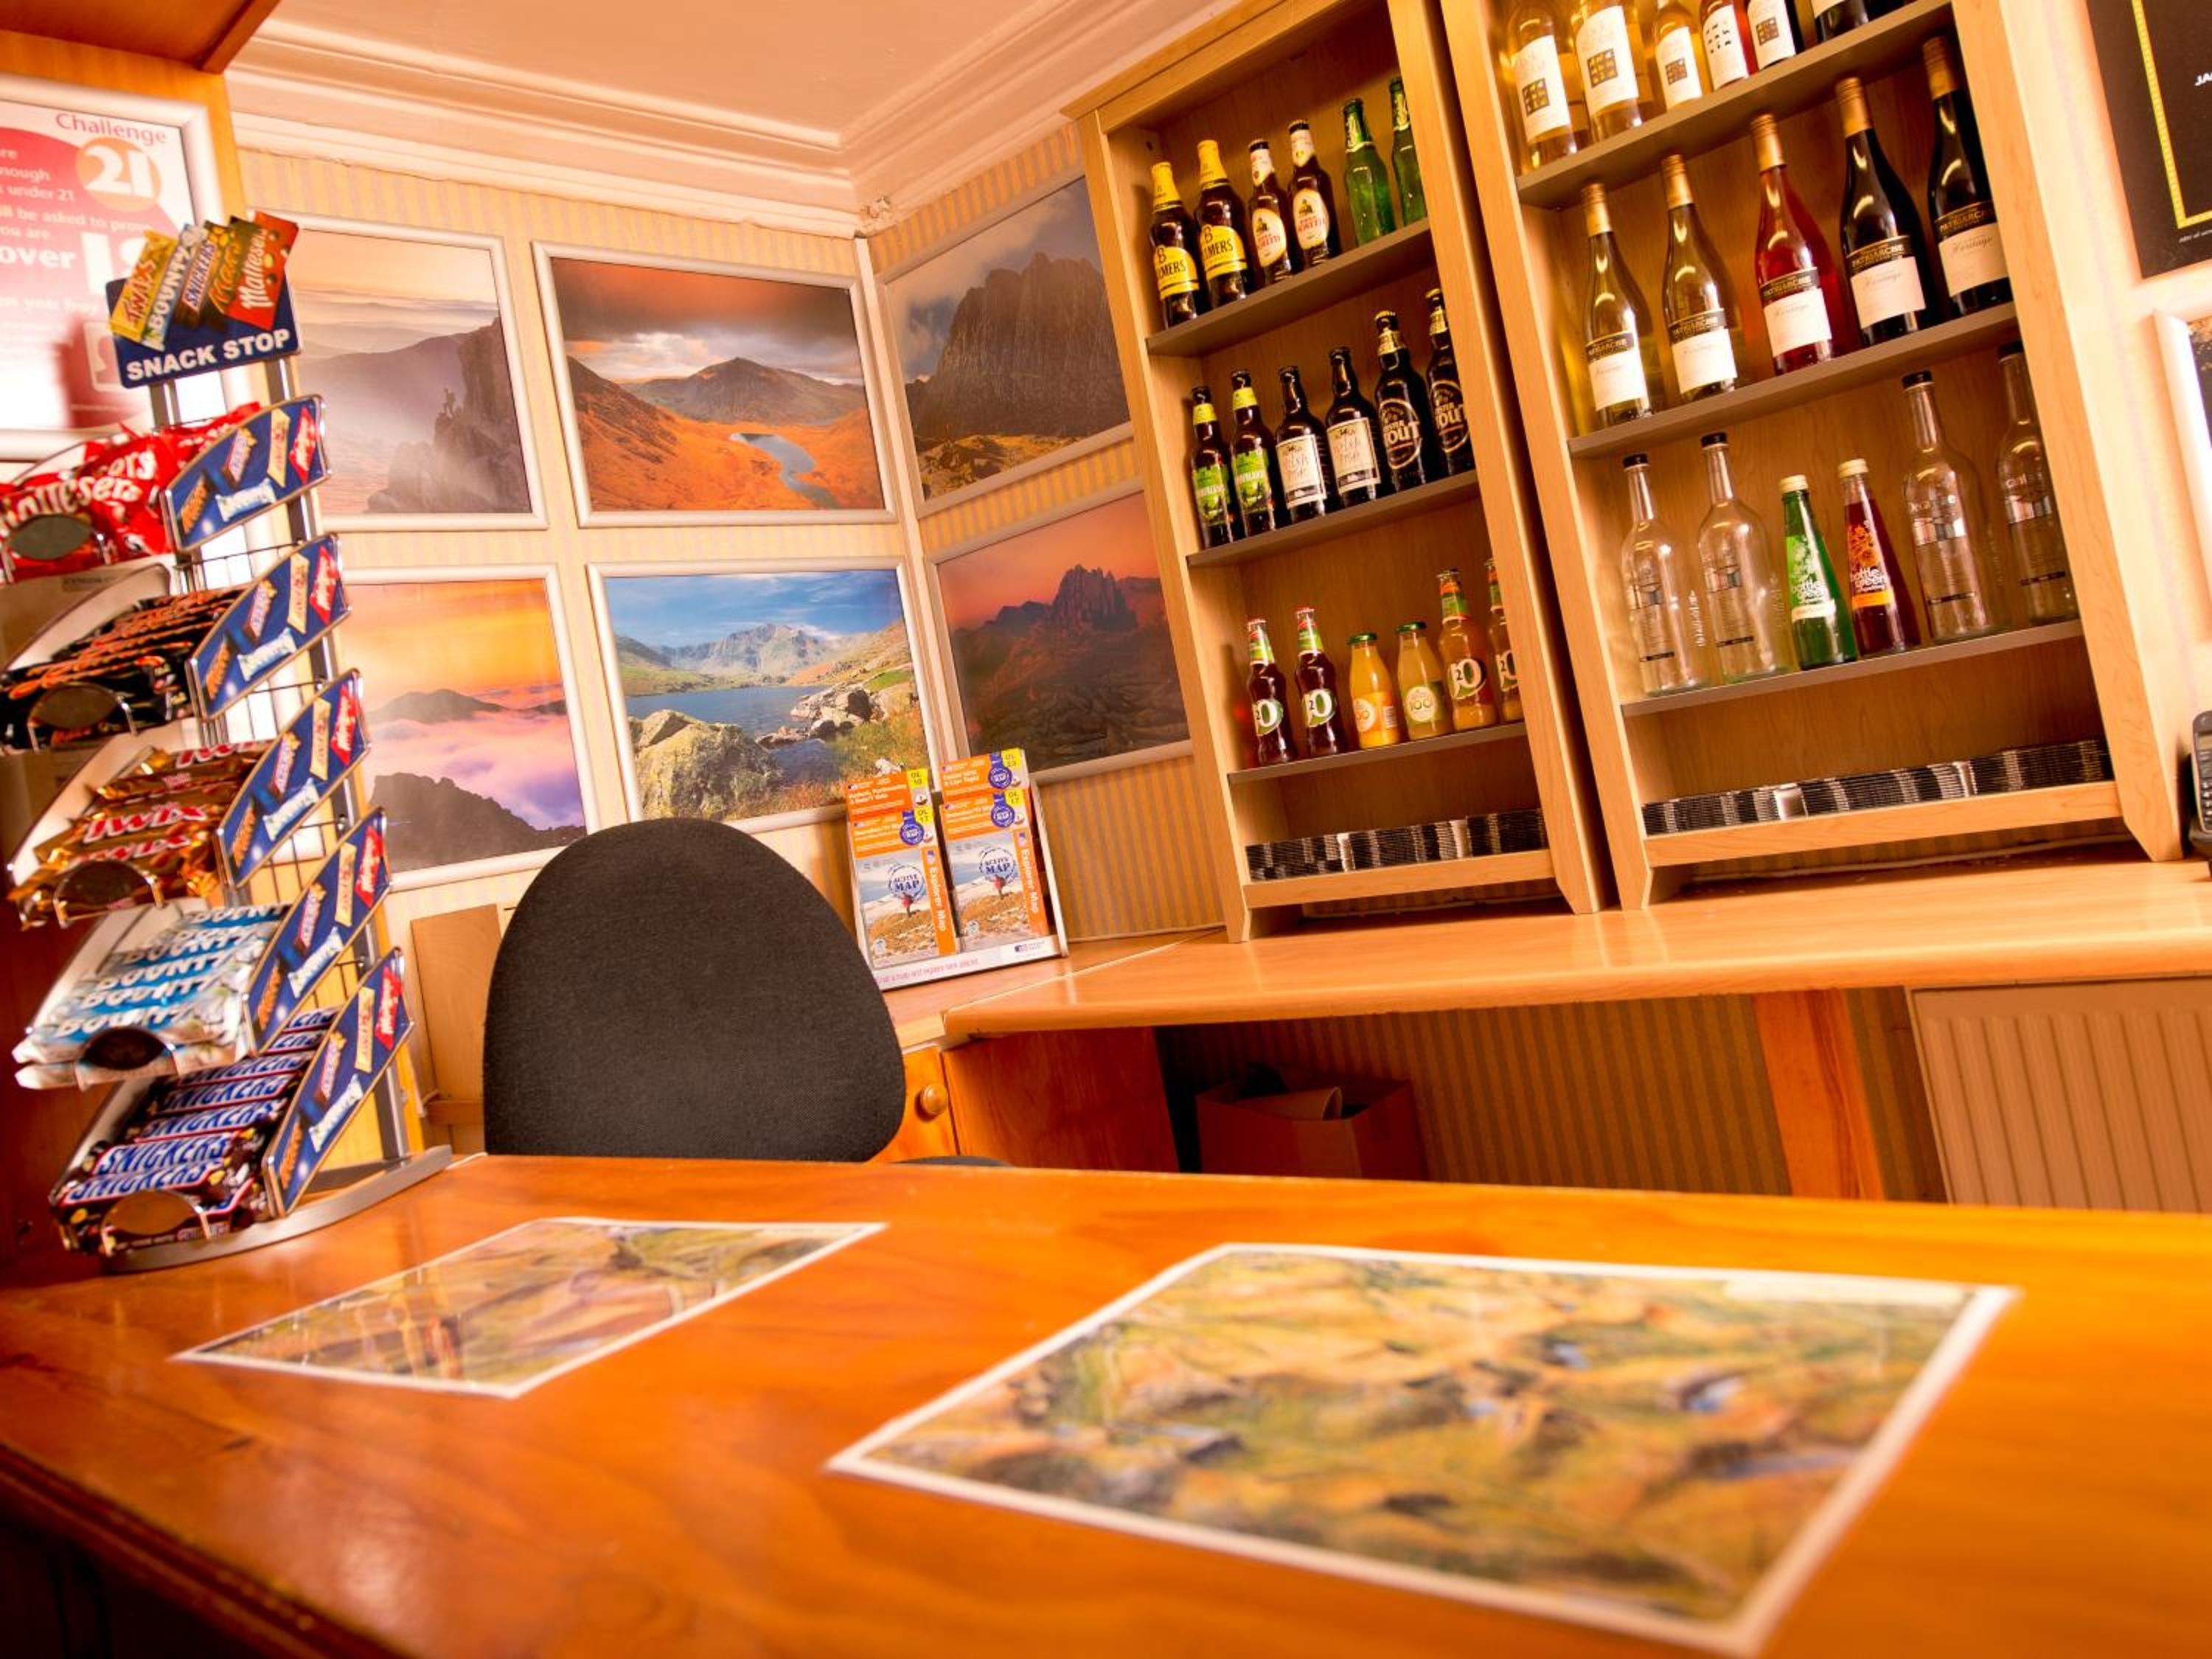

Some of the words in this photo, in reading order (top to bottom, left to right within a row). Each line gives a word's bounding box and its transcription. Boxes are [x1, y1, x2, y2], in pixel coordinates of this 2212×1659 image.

[55, 112, 167, 147] Challenge
[0, 164, 52, 184] nough
[83, 145, 154, 198] 21
[8, 186, 54, 200] under
[58, 188, 74, 201] 21
[0, 244, 77, 269] over
[185, 240, 216, 308] SNICKERS
[150, 245, 191, 330] BOUNTY
[126, 344, 218, 380] SNACK
[223, 328, 290, 360] STOP
[83, 806, 208, 844] TWIX
[895, 880, 921, 893] MAP
[986, 862, 1012, 875] MAP
[929, 866, 942, 908] Explorer
[936, 909, 947, 933] Map
[96, 950, 239, 991] BOUNTY
[79, 973, 221, 1010] BOUNTY
[143, 1098, 284, 1139] SNICKERS
[97, 1133, 232, 1177] SNICKERS
